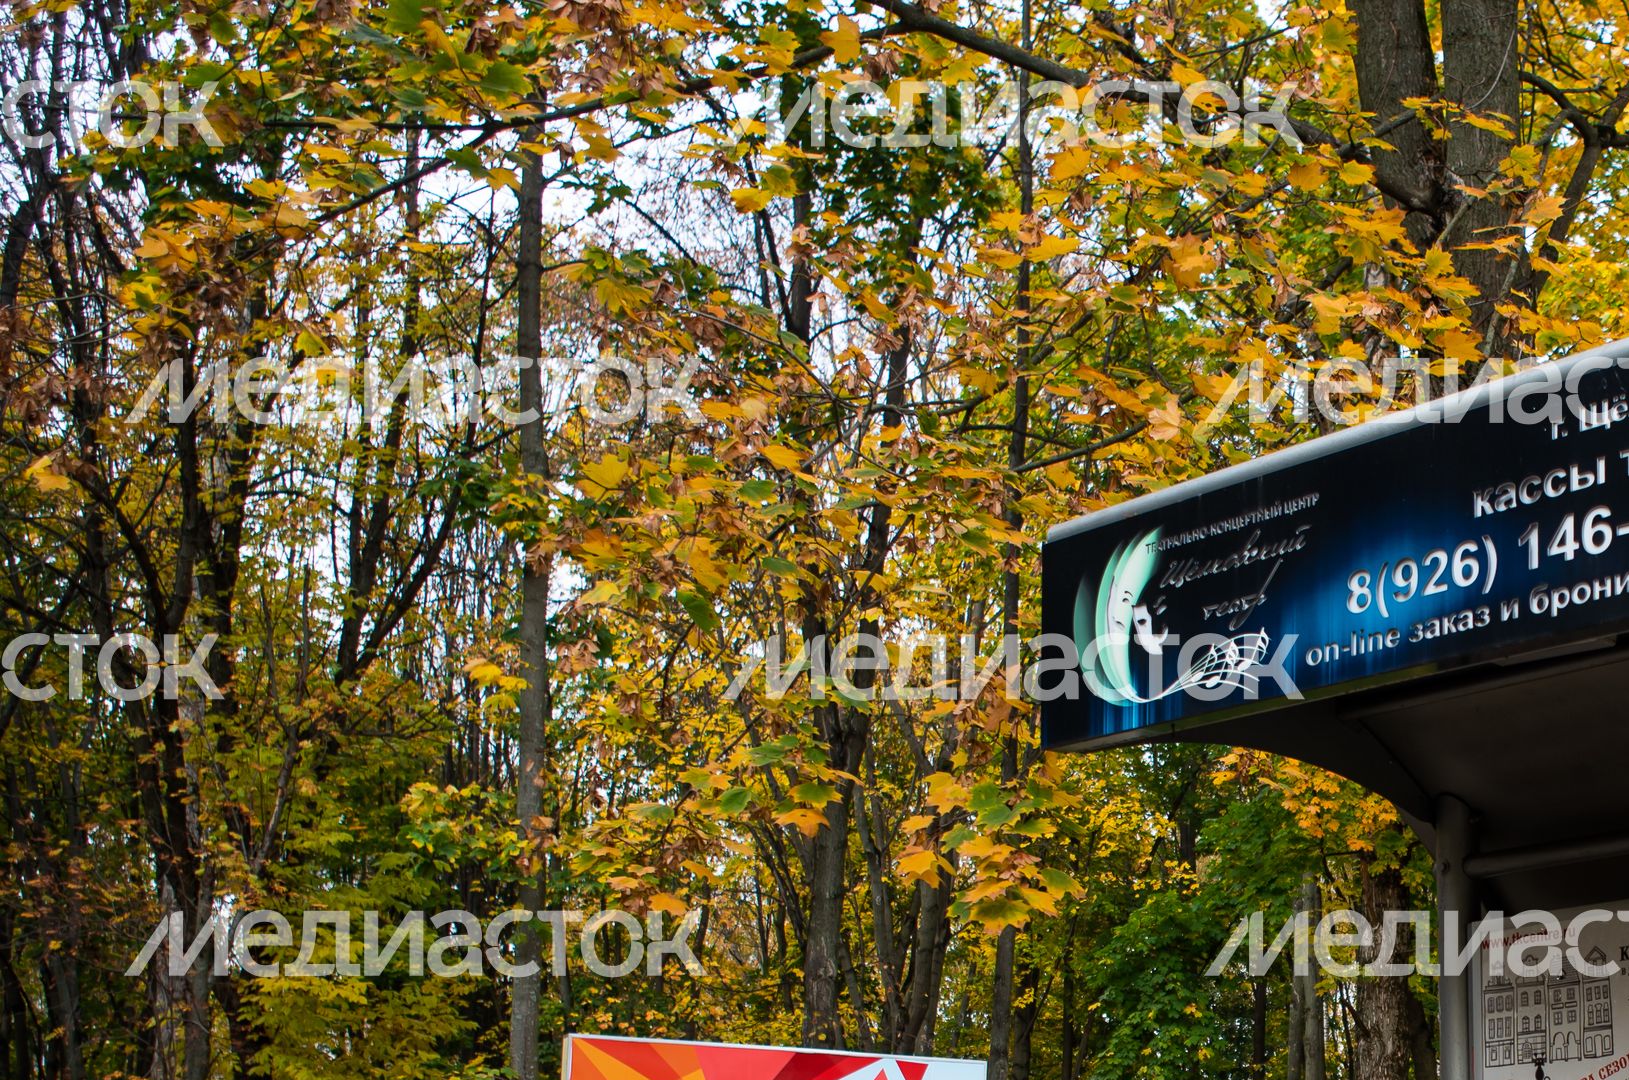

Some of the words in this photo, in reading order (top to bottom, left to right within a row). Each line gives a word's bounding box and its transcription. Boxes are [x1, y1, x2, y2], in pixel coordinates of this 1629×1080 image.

[1551, 418, 1568, 440] г.
[1284, 492, 1320, 516] ЦЕНТР
[1472, 456, 1606, 518] кассы
[1346, 534, 1498, 618] 8(926)
[1305, 629, 1400, 666] on-line
[1408, 608, 1490, 643] заказ
[1500, 599, 1519, 622] и
